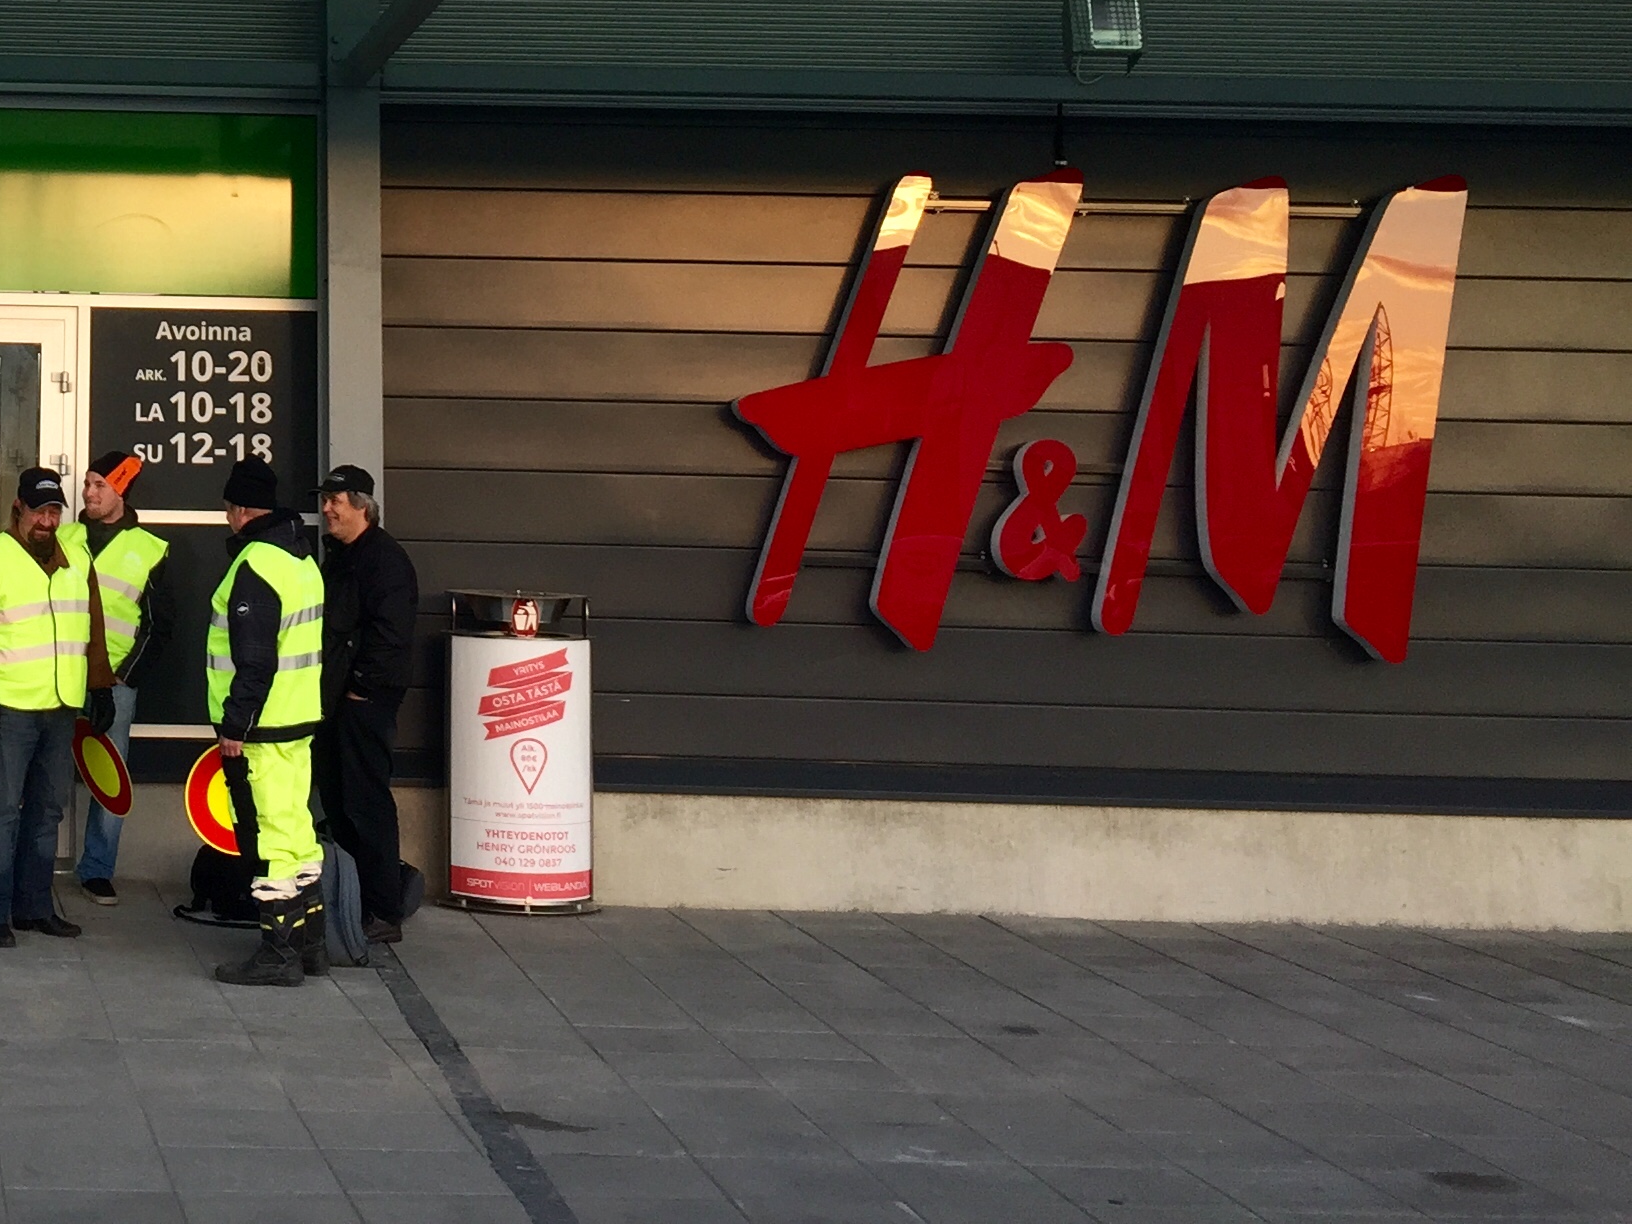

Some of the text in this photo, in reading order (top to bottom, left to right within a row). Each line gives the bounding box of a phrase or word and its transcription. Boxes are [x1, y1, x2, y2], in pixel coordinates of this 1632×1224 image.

[155, 320, 252, 342] Avoinna
[135, 350, 273, 383] ARK. 10-20
[135, 390, 273, 424] LA 10-18
[731, 169, 1468, 664] H&M
[133, 432, 273, 465] SU 12-18
[512, 660, 546, 676] YRITYS
[492, 678, 563, 708] OSTA TÄSTÄ
[494, 708, 560, 733] MAINOSTILAA
[476, 841, 515, 853] HENRY
[484, 828, 570, 842] YHTEYDENOTOT
[494, 855, 516, 867] 040
[519, 857, 536, 868] 129
